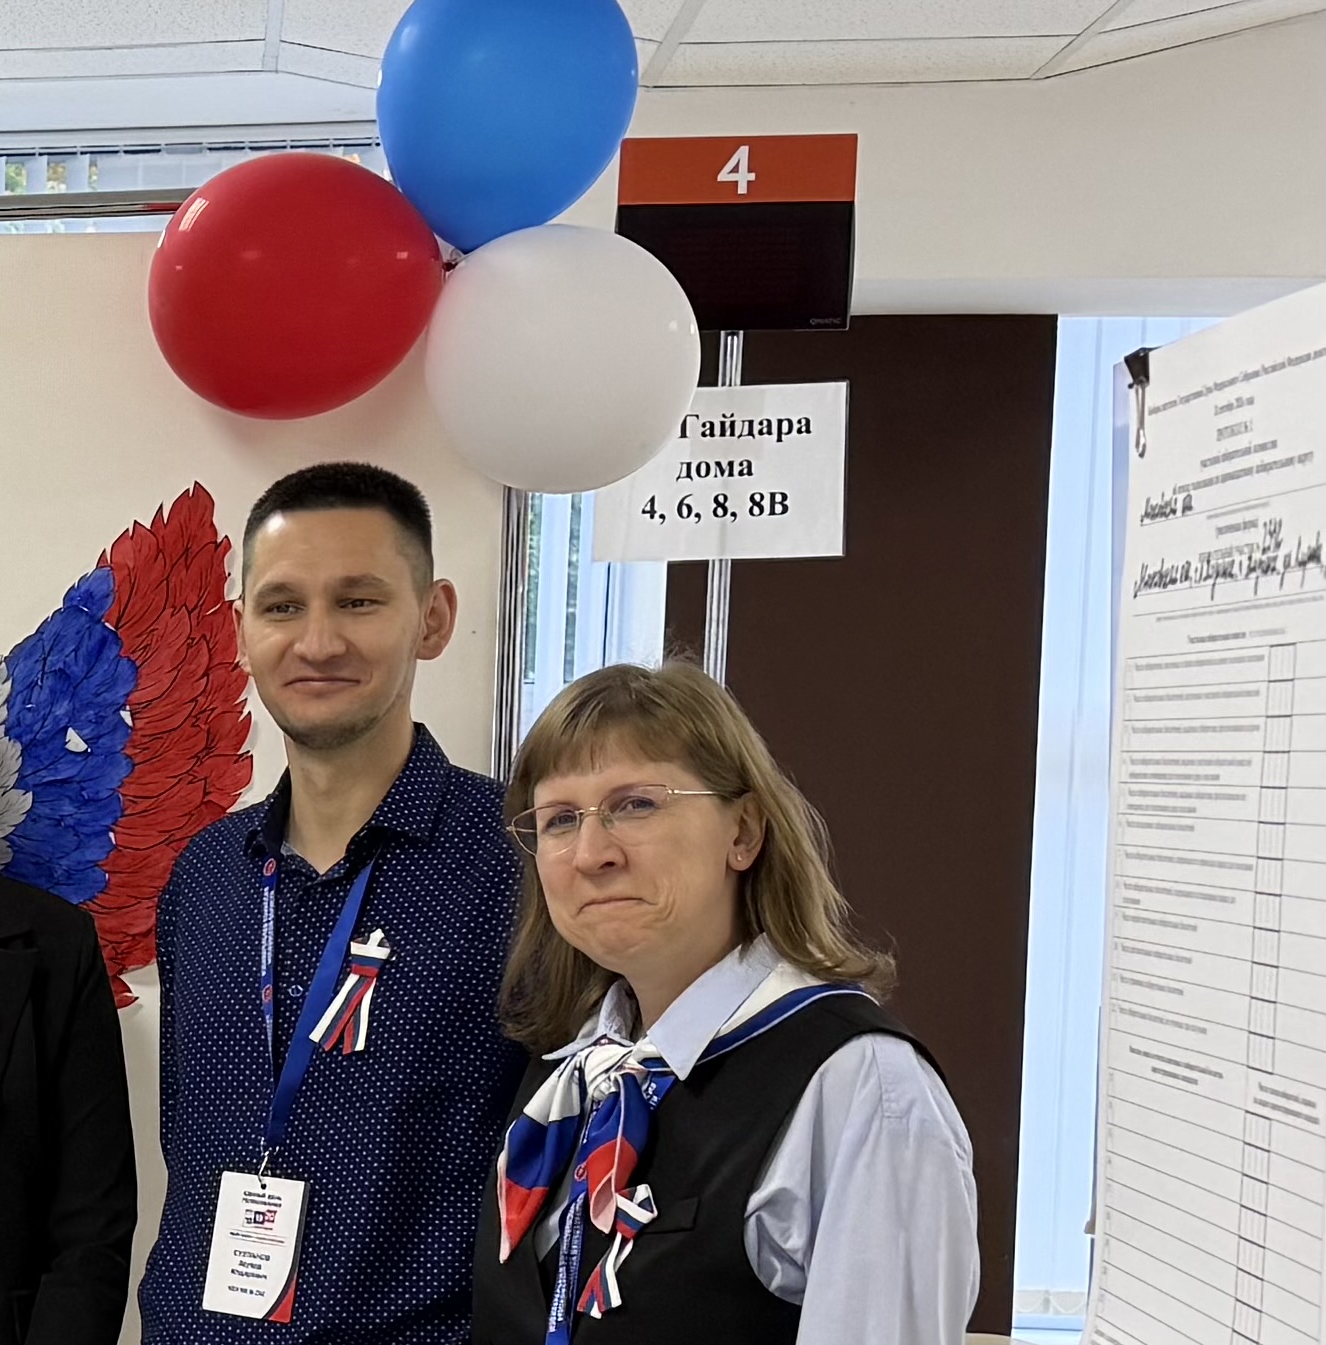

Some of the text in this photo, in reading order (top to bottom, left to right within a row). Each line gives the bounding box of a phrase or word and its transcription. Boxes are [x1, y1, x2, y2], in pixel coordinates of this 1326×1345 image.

[716, 145, 756, 195] 4
[678, 412, 812, 443] Гайдара
[675, 459, 754, 482] дома
[641, 491, 790, 525] 4, 6, 8, 8В
